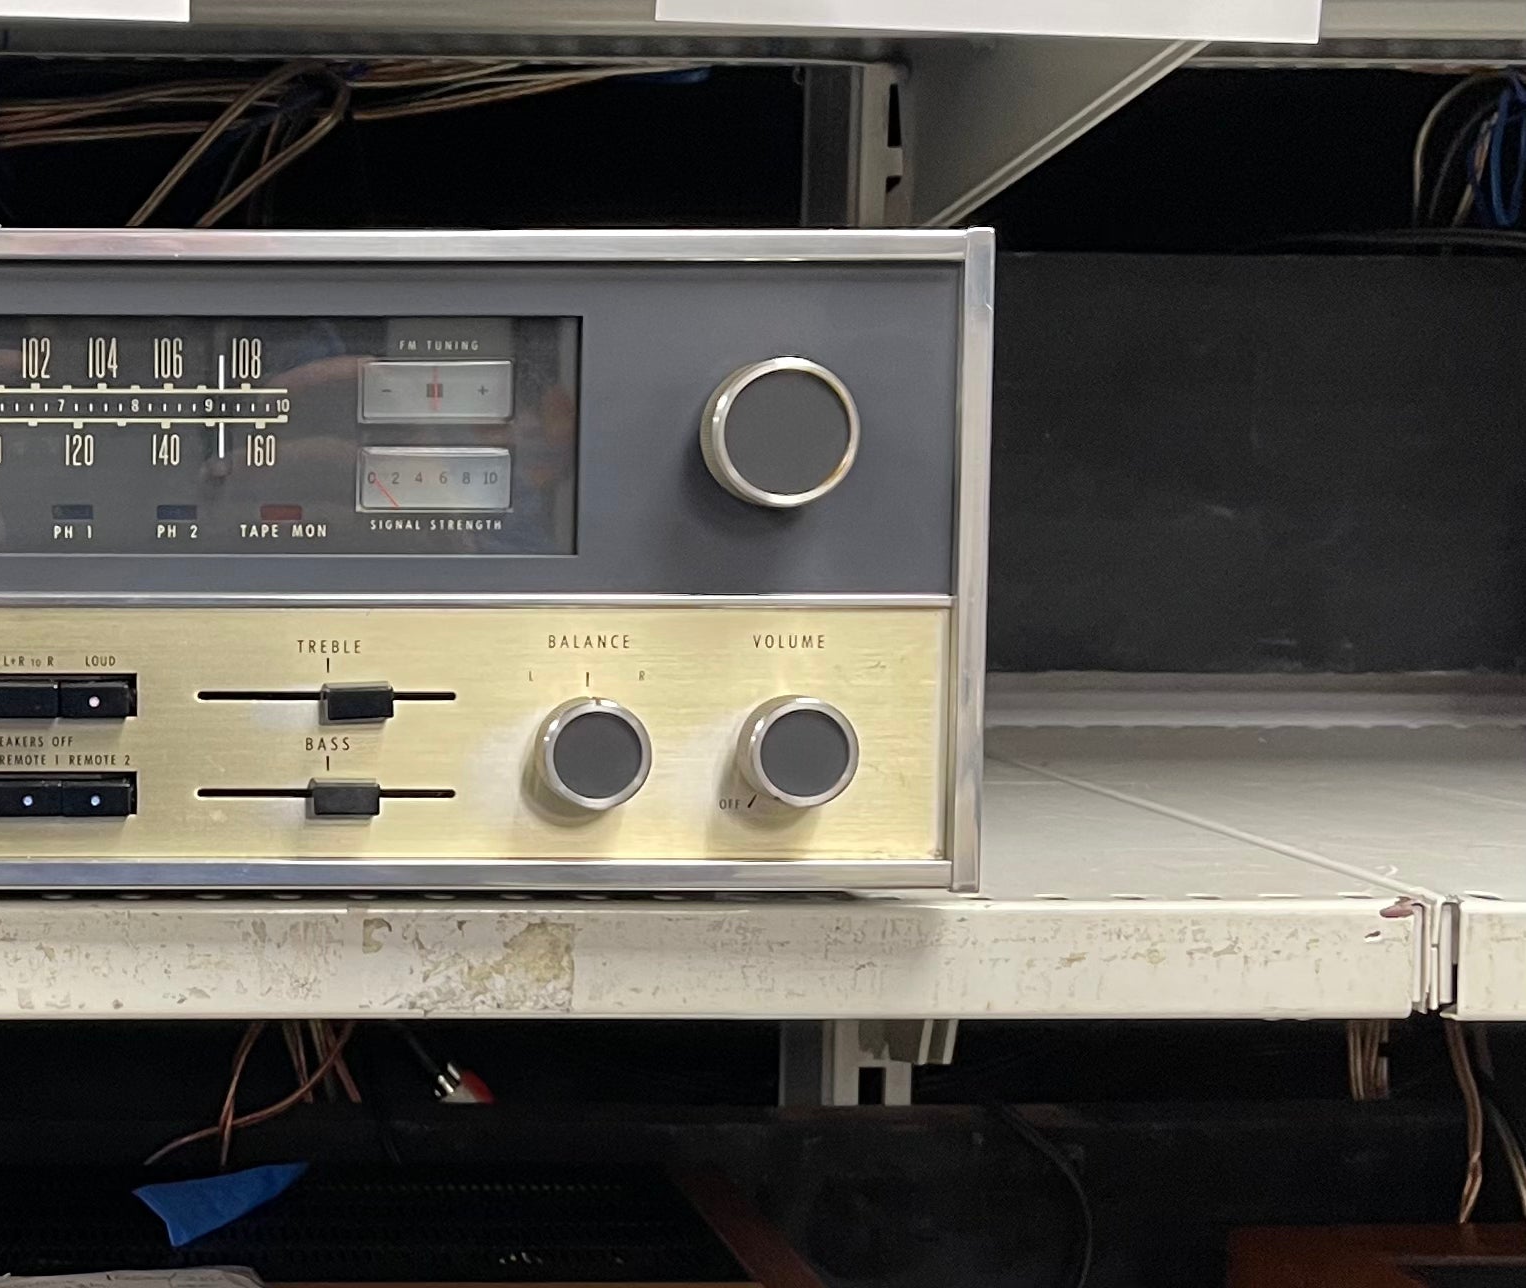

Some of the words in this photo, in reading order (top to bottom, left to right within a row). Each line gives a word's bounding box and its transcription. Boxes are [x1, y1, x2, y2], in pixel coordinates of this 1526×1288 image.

[398, 339, 418, 351] FM
[426, 340, 481, 351] TUNING
[22, 336, 51, 380] 102
[88, 336, 119, 380] 104
[153, 336, 183, 380] 106
[232, 336, 262, 380] 108
[58, 398, 66, 412] 7
[131, 398, 139, 412] 8
[204, 398, 213, 412] 9
[275, 398, 290, 412] 10
[65, 432, 94, 467] 120
[152, 432, 181, 467] 140
[246, 432, 276, 467] 160
[367, 471, 376, 485] 0
[391, 471, 399, 485] 2
[414, 471, 423, 485] 4
[439, 471, 447, 485] 6
[462, 471, 471, 485] 8
[483, 471, 498, 485] 10
[240, 524, 280, 539] TAPE
[292, 524, 328, 539] MON
[370, 519, 421, 531] SIGNAL
[429, 519, 502, 531] STRENGTH
[53, 526, 74, 540] PH
[86, 526, 93, 540] 1
[156, 526, 178, 540] PH
[189, 526, 199, 540] 2
[297, 639, 362, 654] TREBLE
[547, 634, 630, 649] BALANCE
[753, 634, 825, 649] VOLUME
[3, 655, 25, 667] L+R
[47, 655, 54, 667] R
[85, 655, 116, 667] LOUD
[528, 670, 534, 681] L
[638, 670, 646, 681] R
[52, 736, 74, 747] OFF
[305, 737, 350, 751] BASS
[0, 754, 46, 766] REMOTE
[55, 754, 59, 766] 1
[69, 754, 116, 766] REMOTE
[124, 754, 130, 766] 2
[719, 799, 740, 810] OFF
